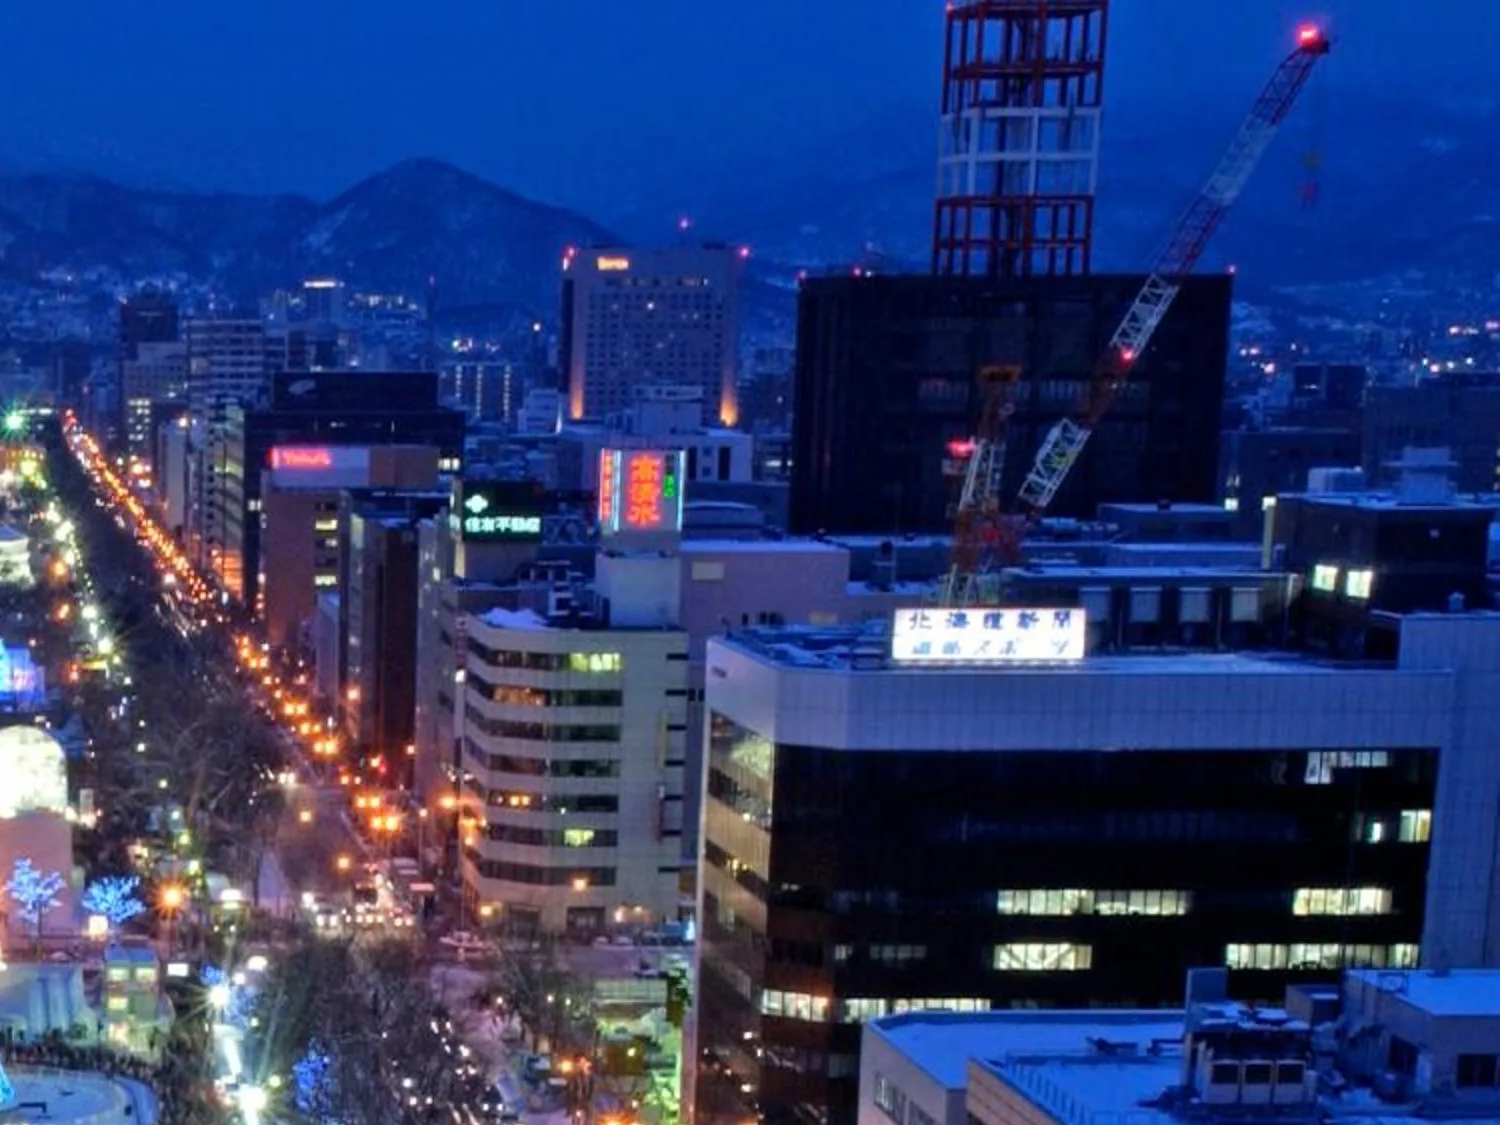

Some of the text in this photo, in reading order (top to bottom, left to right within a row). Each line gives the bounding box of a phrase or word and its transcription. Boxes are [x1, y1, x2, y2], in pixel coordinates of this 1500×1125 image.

[908, 610, 1072, 630] 北海道新聞
[911, 638, 1070, 656] 道新スポツ
